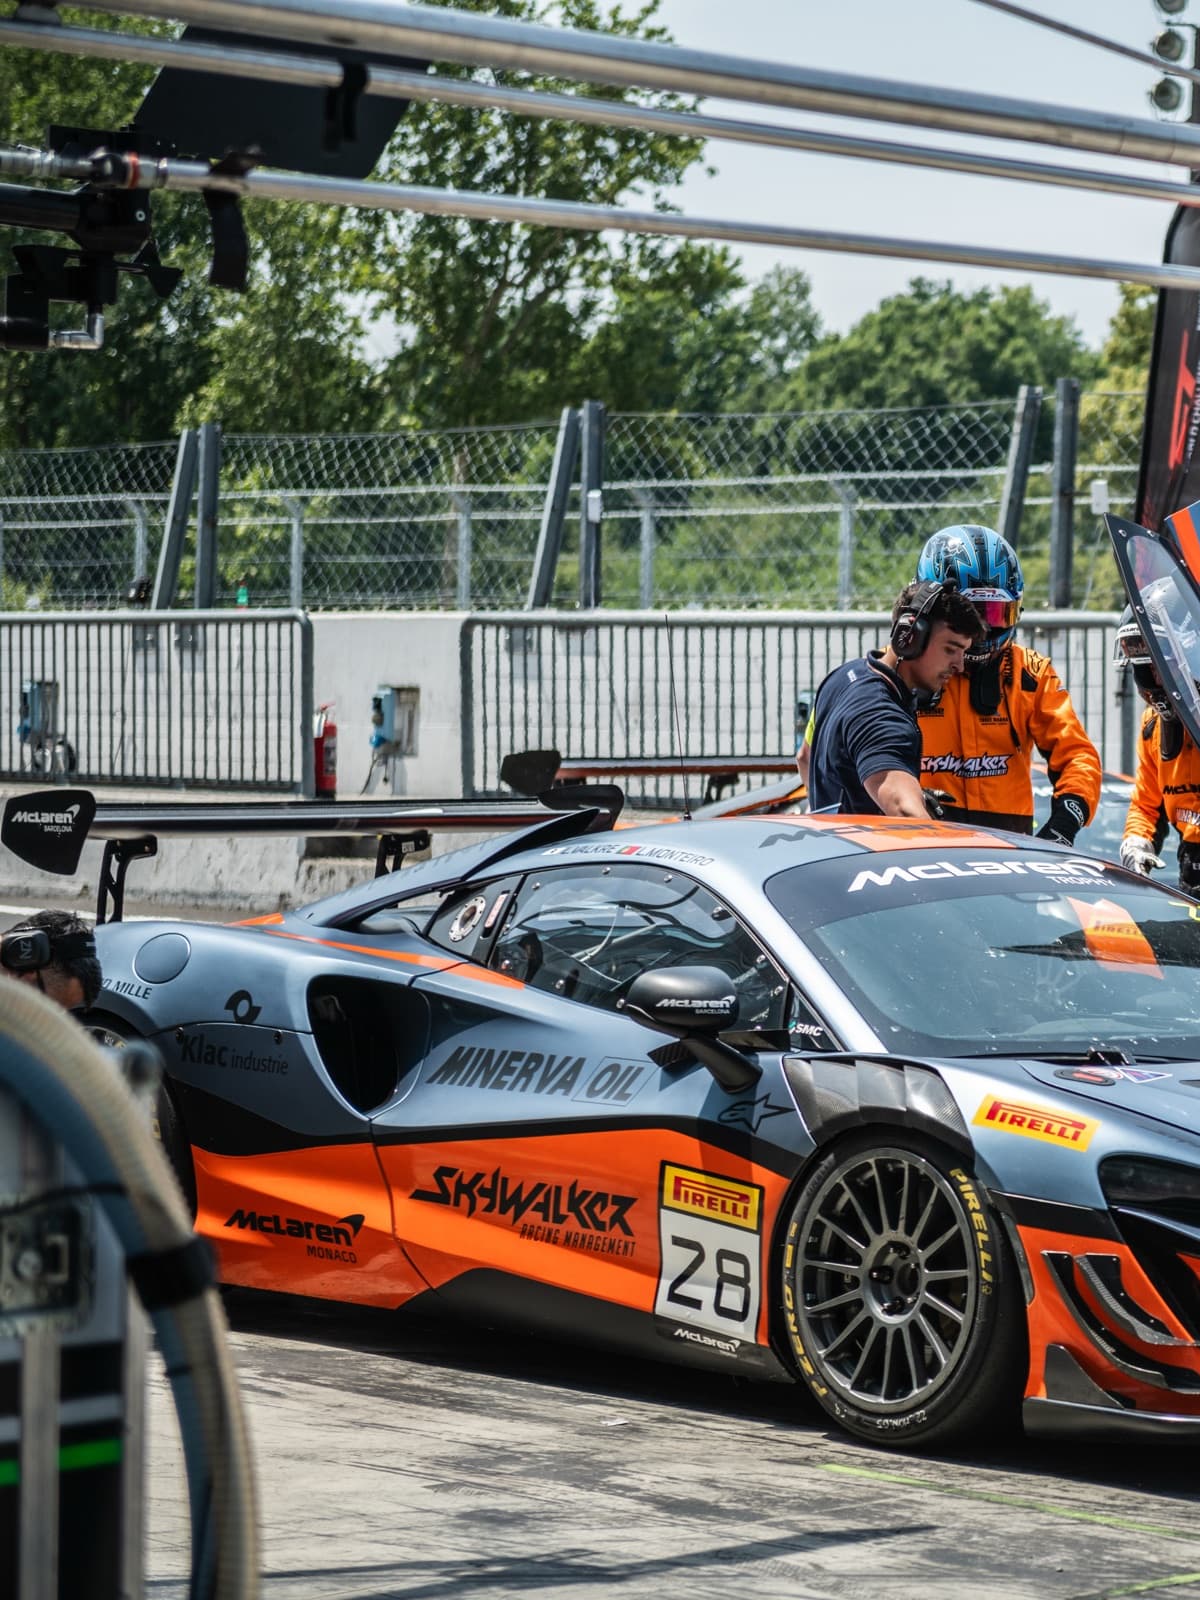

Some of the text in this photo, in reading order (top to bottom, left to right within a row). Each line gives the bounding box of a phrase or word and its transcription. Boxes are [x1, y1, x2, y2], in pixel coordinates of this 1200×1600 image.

[11, 811, 74, 824] McLaren
[847, 860, 1105, 892] McLaren
[1045, 875, 1117, 887] TROPHY
[114, 980, 153, 1000] MILLE
[655, 998, 731, 1009] McLaren
[795, 1023, 824, 1037] SMC
[182, 1033, 290, 1076] Klac industrie
[426, 1046, 645, 1102] MINERVA OIL
[986, 1100, 1087, 1142] PIRELLI
[410, 1165, 640, 1237] SKYWALKER
[673, 1175, 752, 1222] PIRELLI
[223, 1208, 353, 1247] McLaren
[520, 1223, 637, 1258] RACING MANAGEMENT
[949, 1167, 994, 1290] PIRELLI
[306, 1244, 358, 1265] MONACO
[666, 1235, 752, 1324] 28
[673, 1328, 737, 1353] McLaren
[783, 1284, 815, 1378] ZERO
